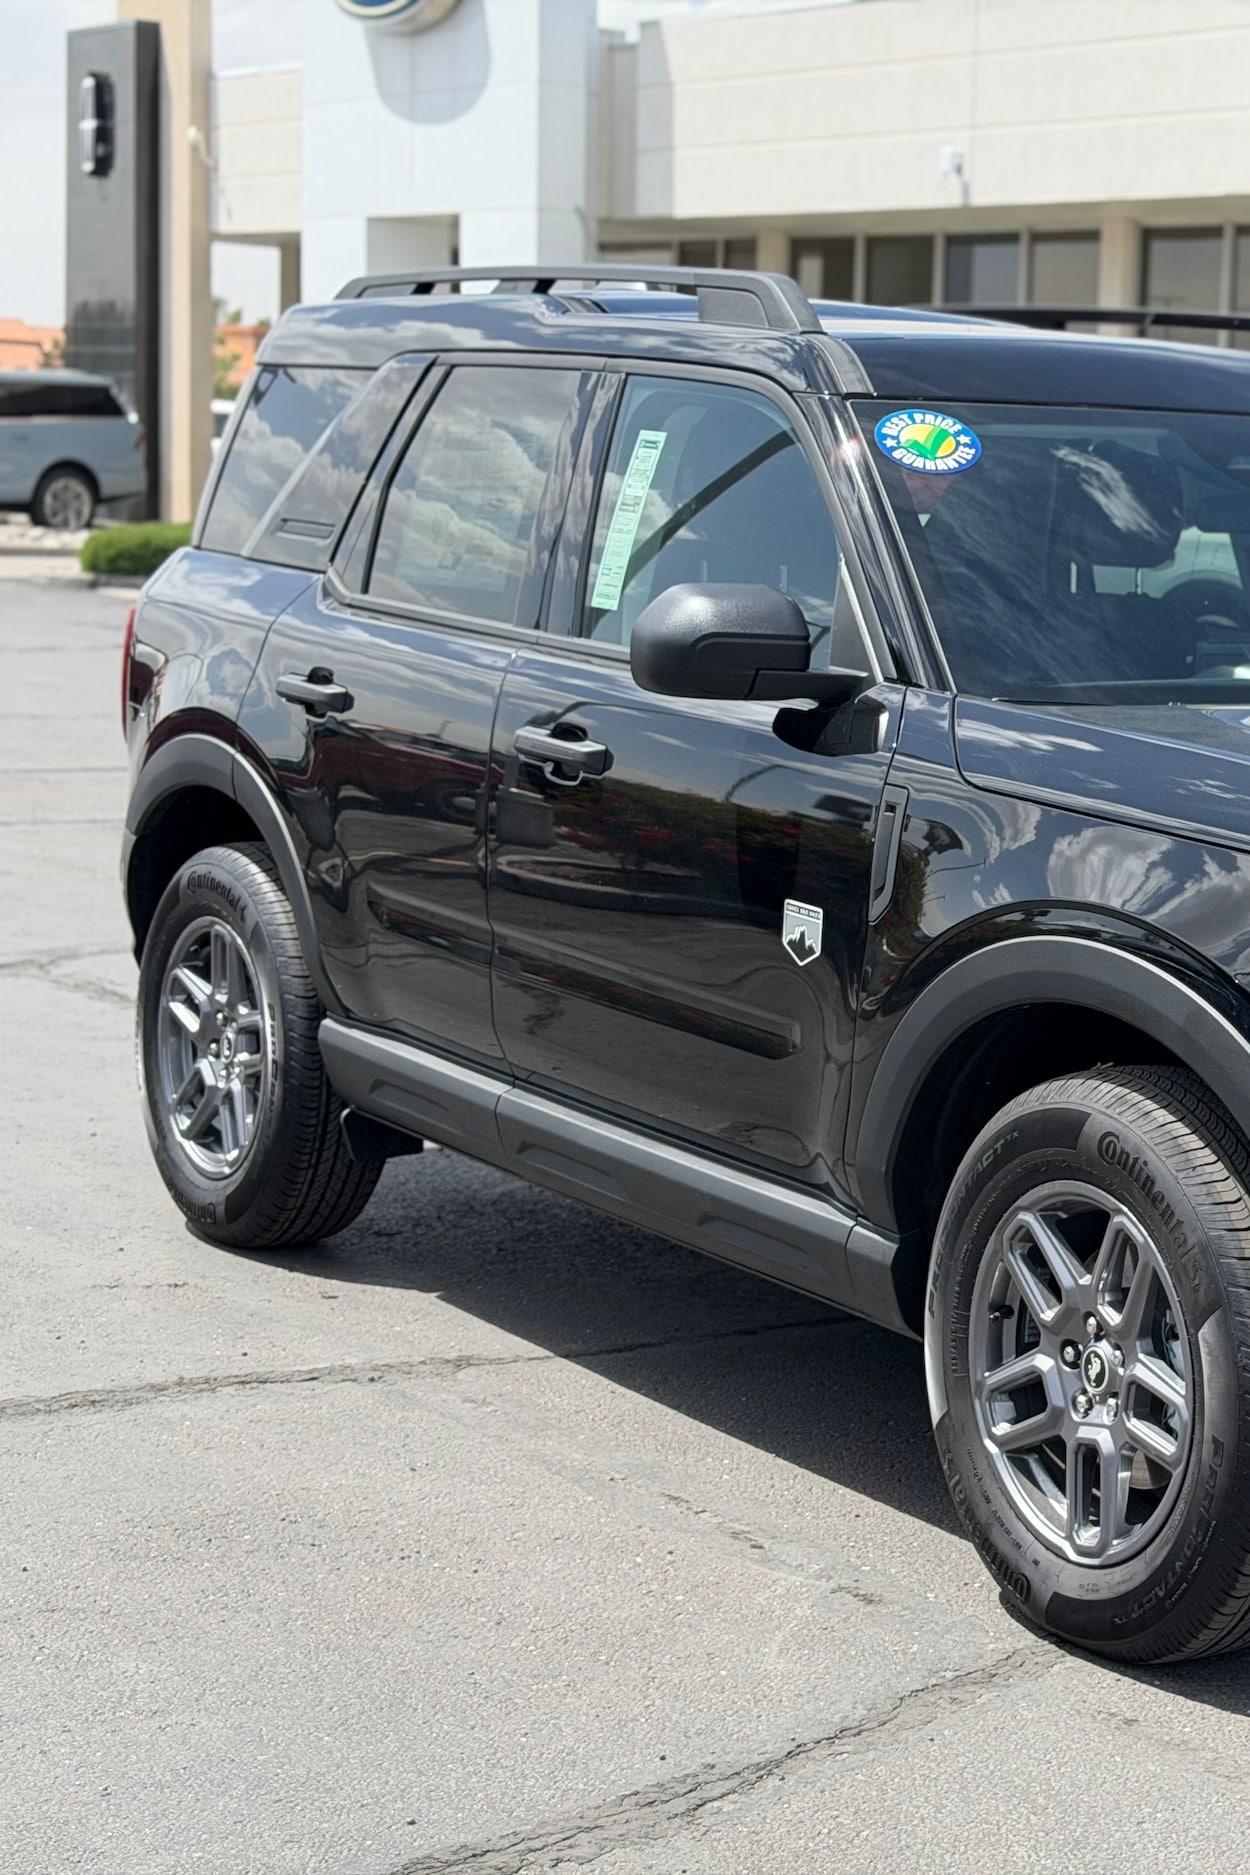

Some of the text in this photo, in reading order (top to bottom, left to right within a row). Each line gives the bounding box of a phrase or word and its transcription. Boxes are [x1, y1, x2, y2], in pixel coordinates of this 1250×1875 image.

[881, 413, 963, 437] BEST PRICE
[892, 445, 976, 470] GUARANTEE
[187, 871, 241, 912] Continental
[1097, 1131, 1196, 1260] Continental
